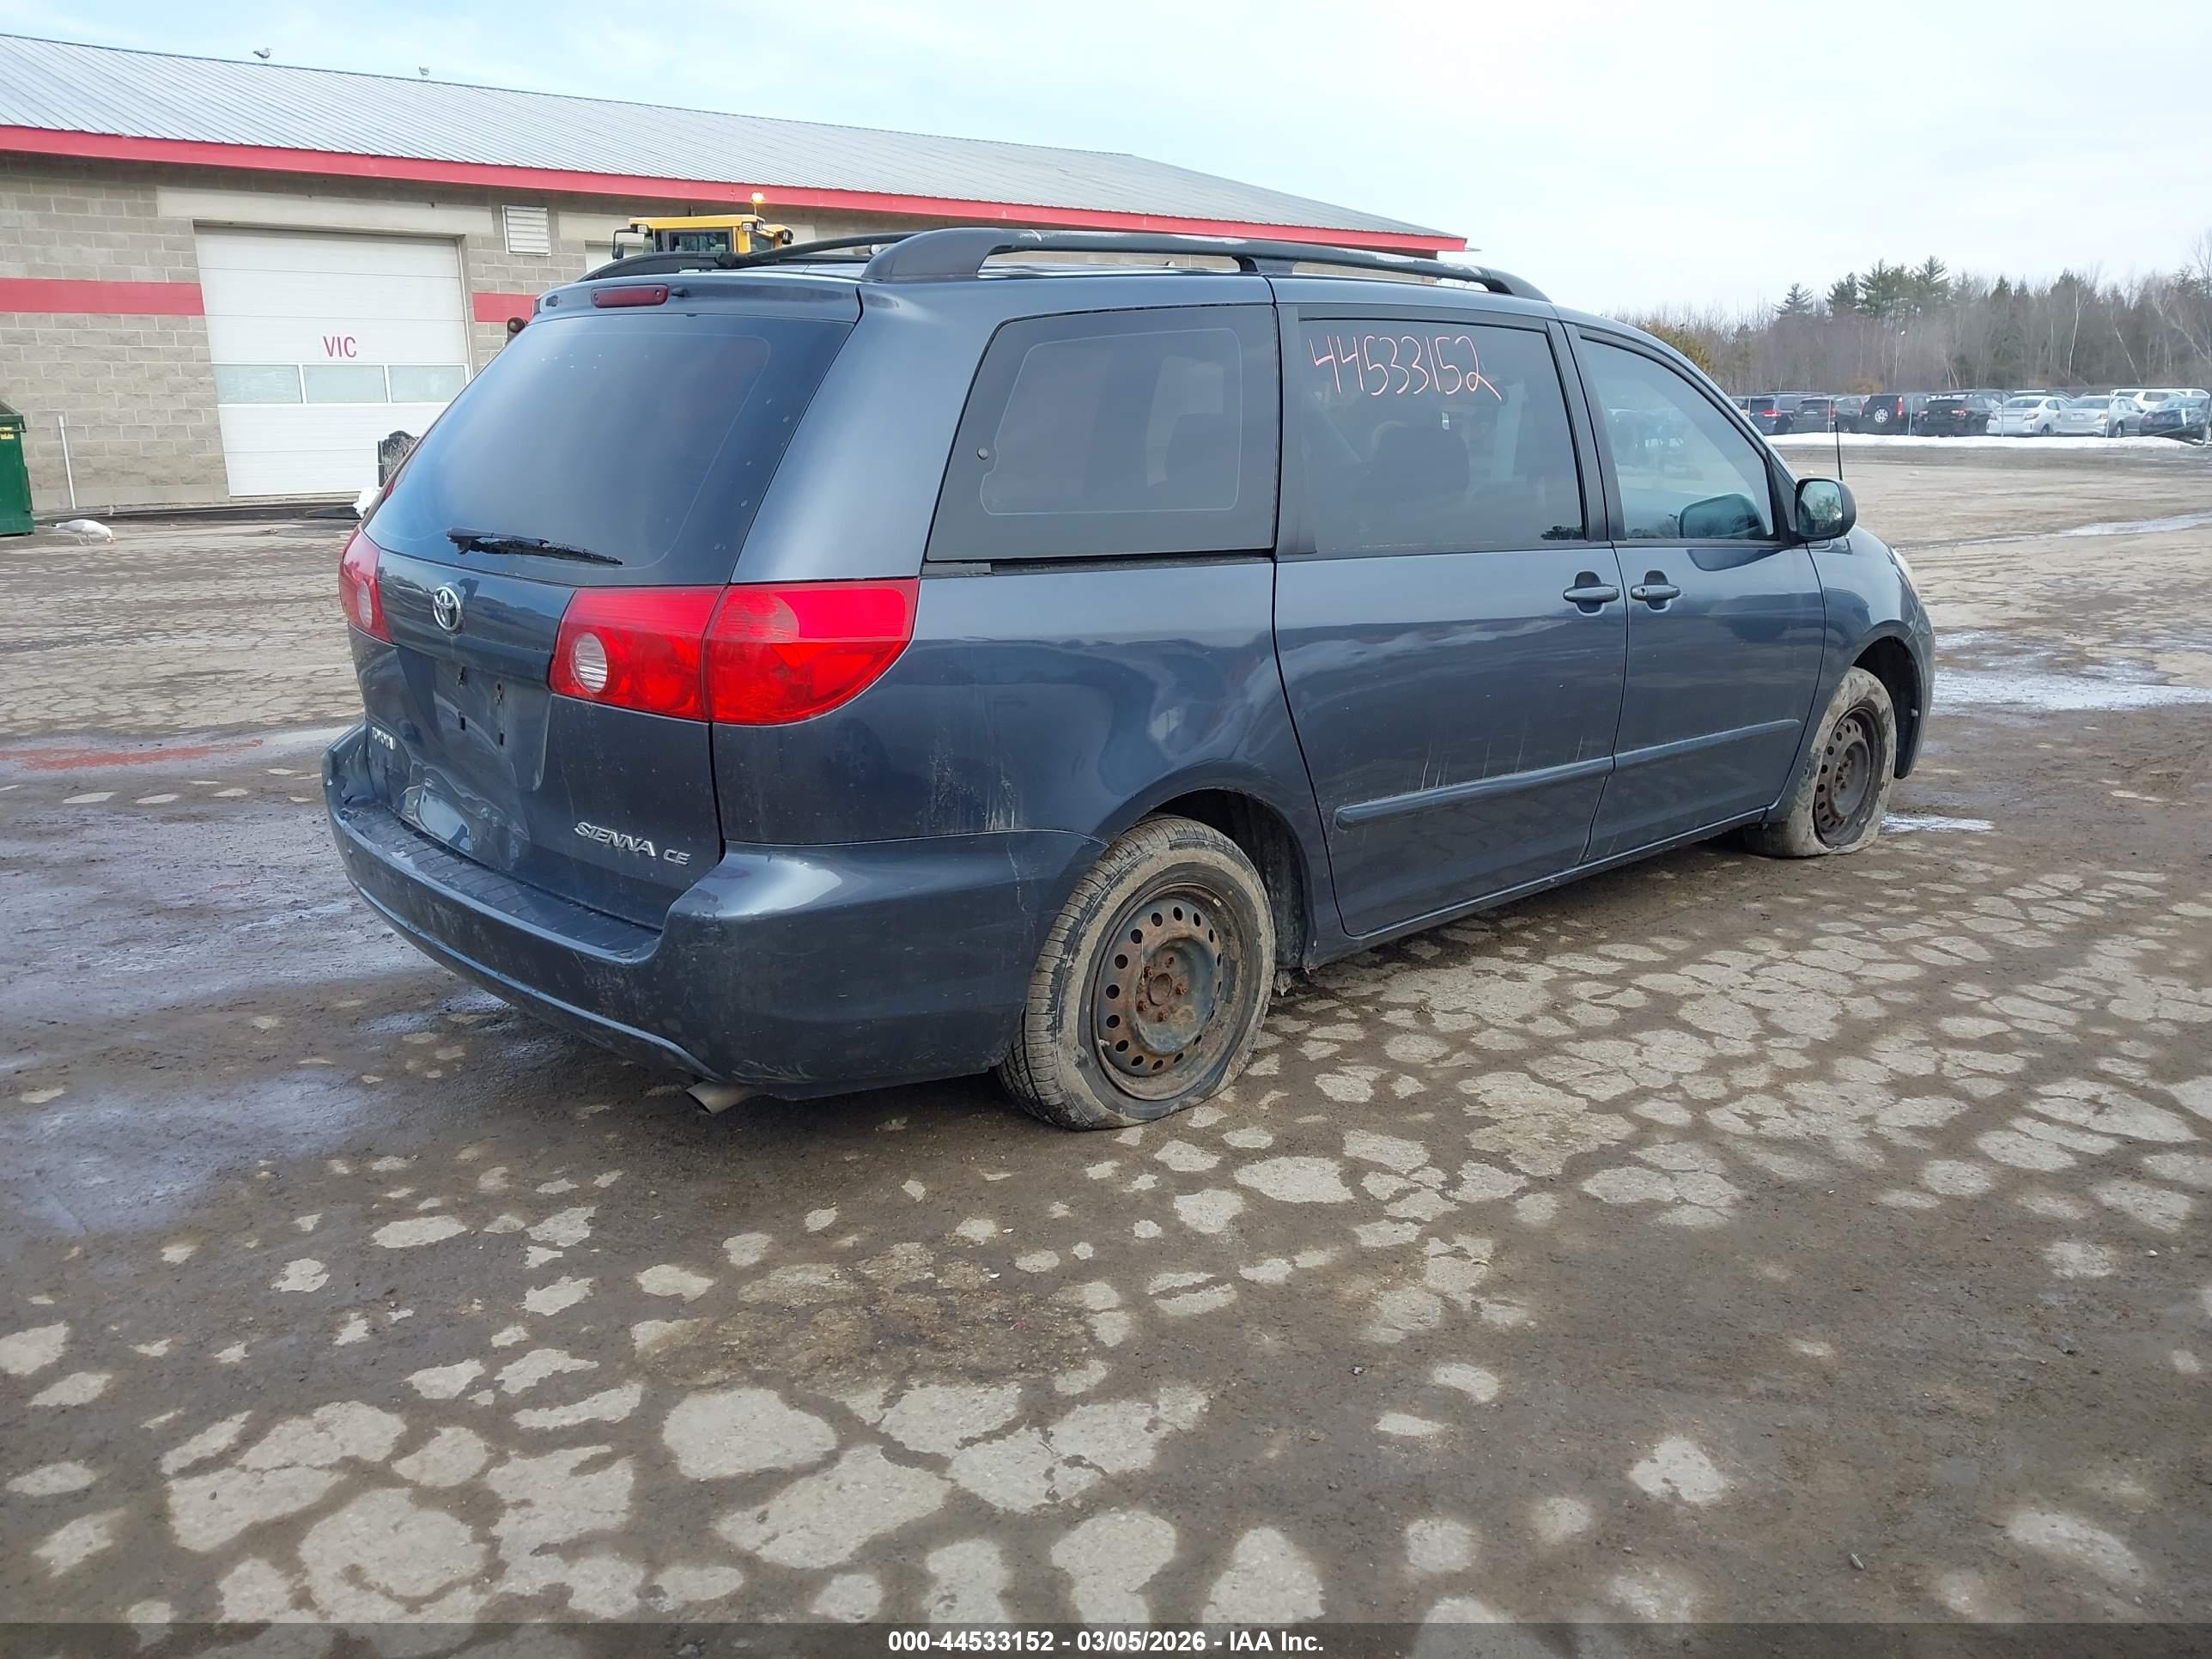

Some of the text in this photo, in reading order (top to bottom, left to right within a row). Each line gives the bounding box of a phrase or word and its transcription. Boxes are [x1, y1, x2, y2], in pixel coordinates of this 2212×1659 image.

[322, 336, 357, 358] VIC
[1309, 335, 1503, 401] 44533152
[574, 822, 691, 866] SIENNA CE
